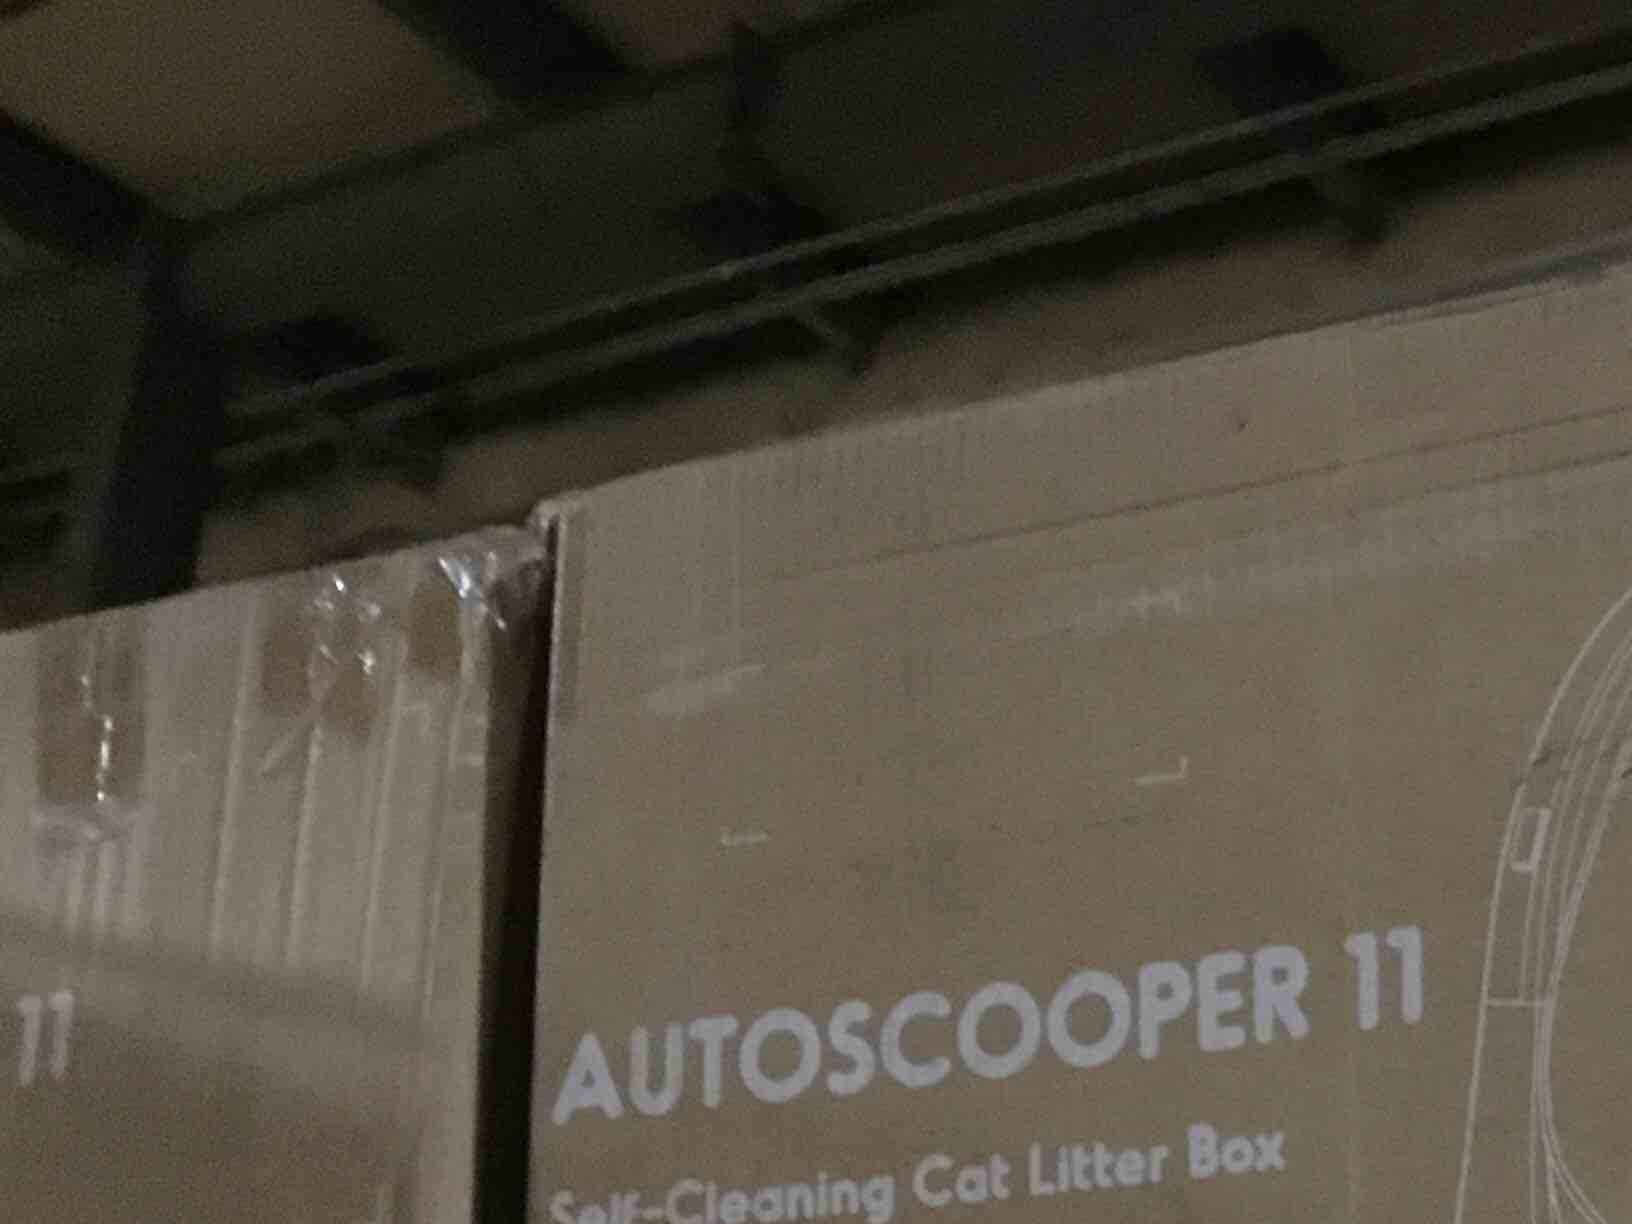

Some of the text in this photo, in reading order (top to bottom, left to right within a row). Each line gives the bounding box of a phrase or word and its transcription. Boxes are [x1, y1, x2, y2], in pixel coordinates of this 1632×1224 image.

[16, 989, 76, 1088] 11
[551, 926, 1426, 1126] AUTOSCOOPER 11
[912, 1152, 1011, 1208] Cat
[1028, 1142, 1169, 1196] Litter
[1187, 1121, 1286, 1180] Box
